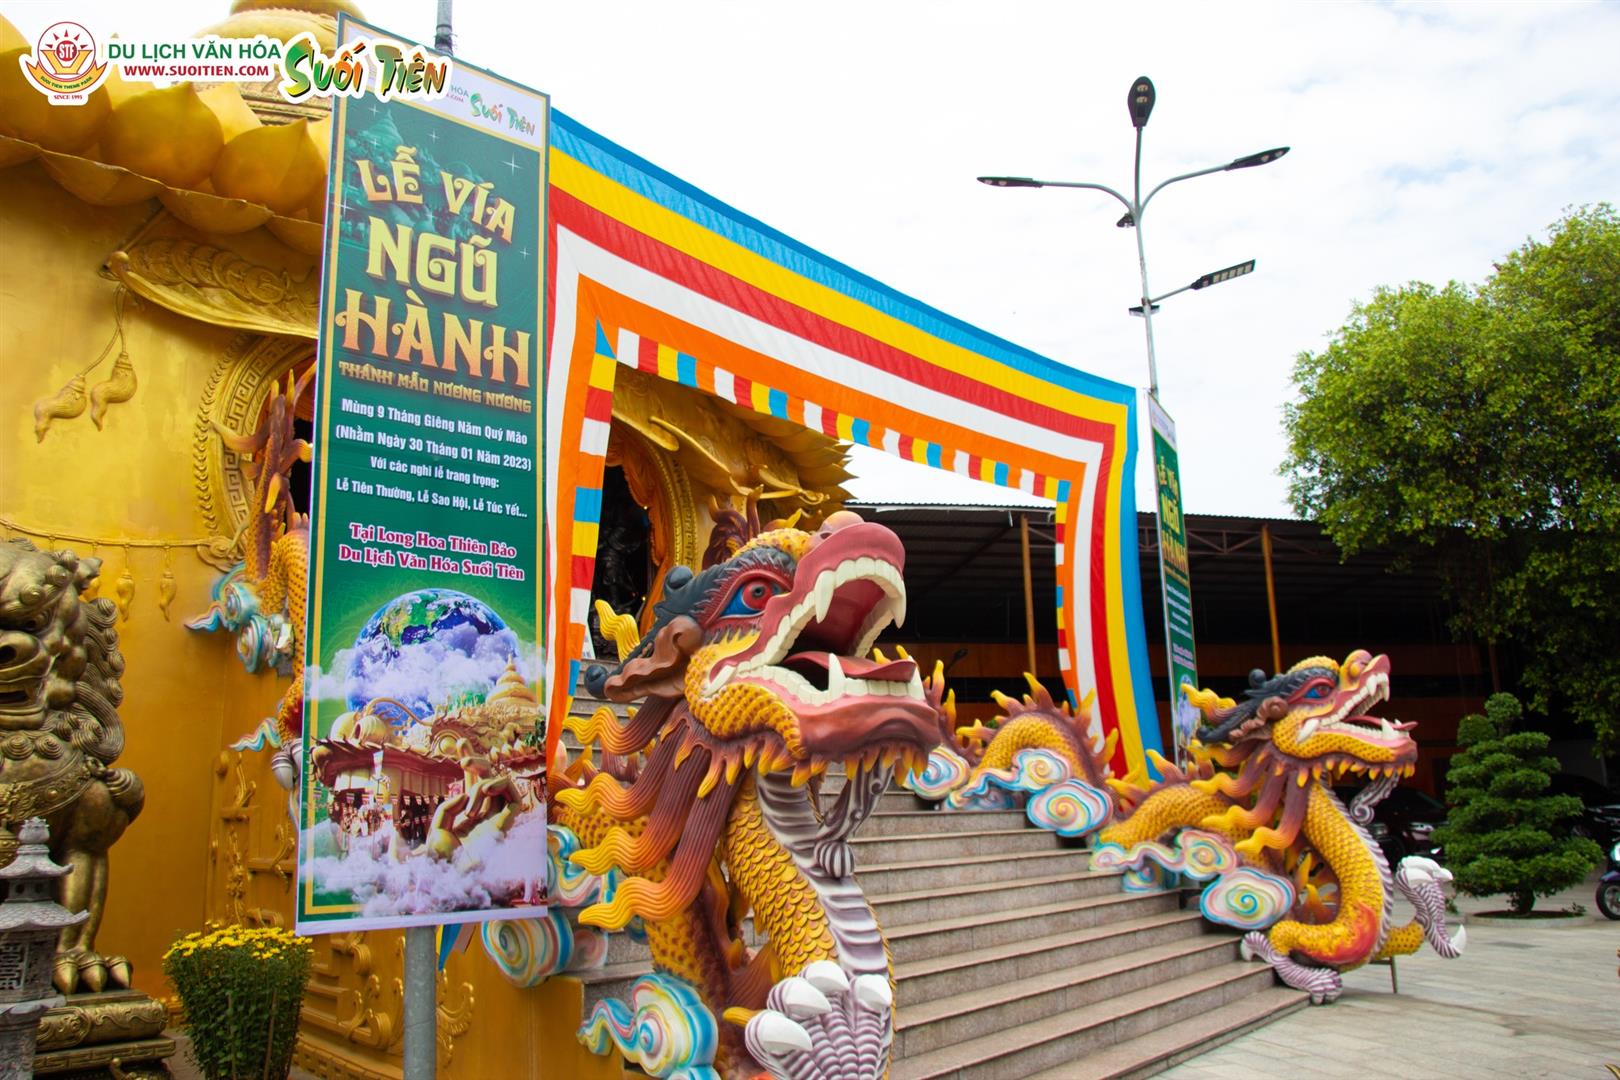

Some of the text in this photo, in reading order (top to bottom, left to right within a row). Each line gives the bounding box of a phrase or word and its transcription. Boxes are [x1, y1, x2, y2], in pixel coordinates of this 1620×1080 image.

[356, 145, 516, 244] LỄ VÍA
[365, 215, 498, 308] NGŨ
[335, 288, 532, 388] HÀNH
[341, 398, 528, 445] Mùng 9 Tháng Giêng Năm Quý Mão
[377, 432, 406, 450] Ngày
[409, 437, 423, 452] 30
[426, 440, 459, 459] Tháng
[461, 446, 473, 461] 01
[476, 449, 501, 466] Năm
[503, 454, 532, 471] 2023)
[370, 456, 499, 489] Với các nghi lễ trang trọng:
[336, 477, 349, 492] Lễ
[352, 480, 374, 495] Tiên
[417, 489, 430, 503] Lễ
[431, 493, 450, 507] Sao
[452, 496, 471, 511] Hội,
[473, 498, 485, 512] Lễ
[486, 501, 503, 514] Túc
[505, 502, 528, 518] Yết...
[350, 522, 517, 558] Tại Long Hoa Thiên Bảo
[339, 544, 525, 581] Du Lịch Văn Hóa Suối Tiên
